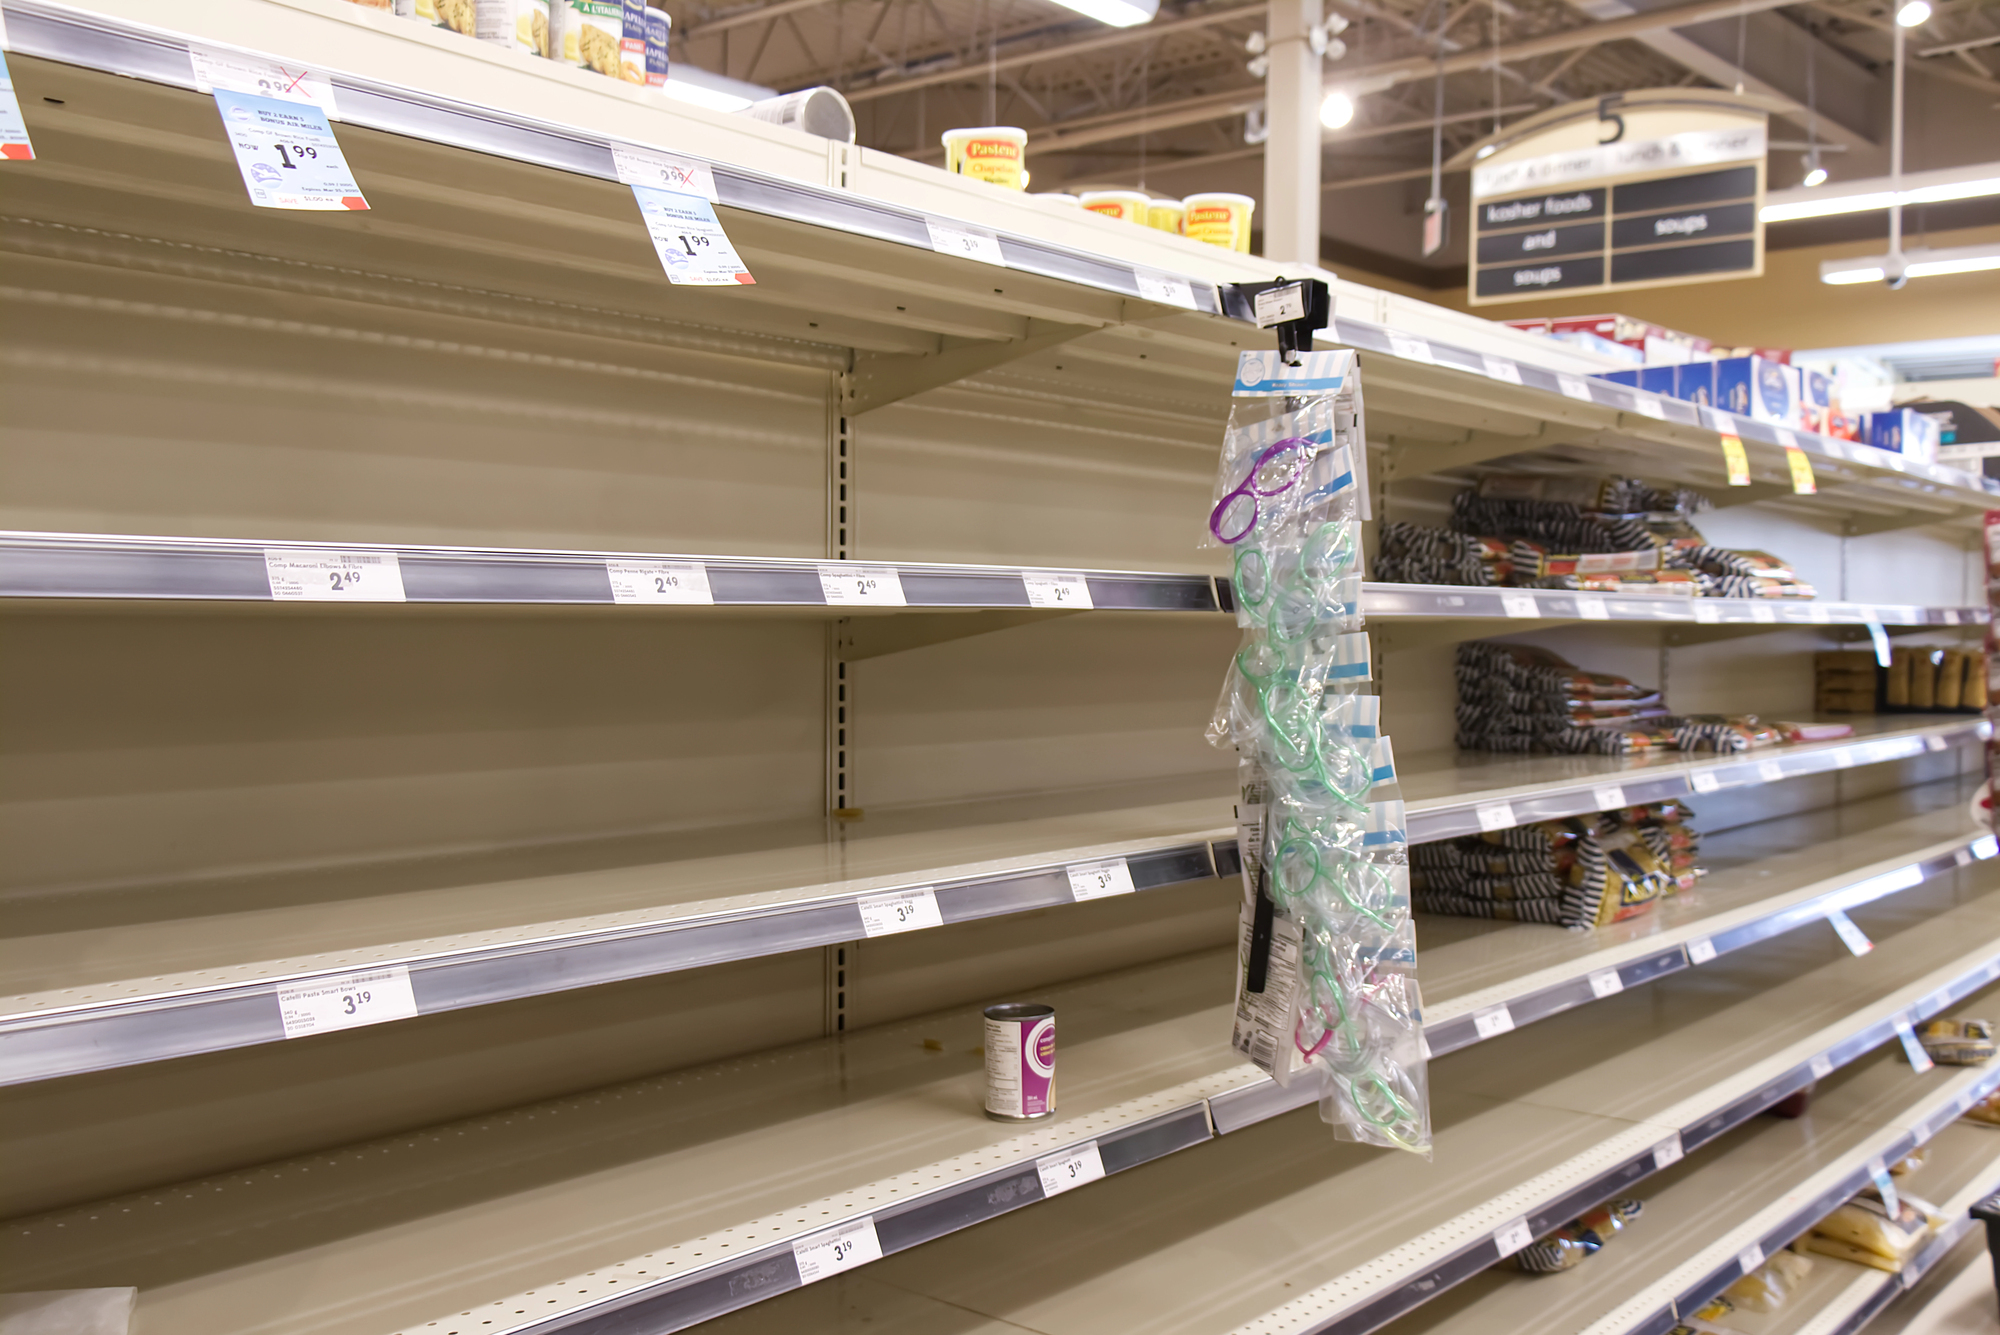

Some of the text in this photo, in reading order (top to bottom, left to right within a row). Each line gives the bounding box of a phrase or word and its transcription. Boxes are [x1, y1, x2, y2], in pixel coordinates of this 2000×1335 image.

[260, 116, 285, 125] BONUS
[1599, 96, 1624, 145] 5
[238, 142, 258, 150] NOW
[1191, 211, 1229, 220] Pastene
[1487, 193, 1592, 222] kosher foods
[1655, 215, 1708, 236] soups
[1522, 229, 1556, 251] and
[1514, 266, 1562, 286] soups
